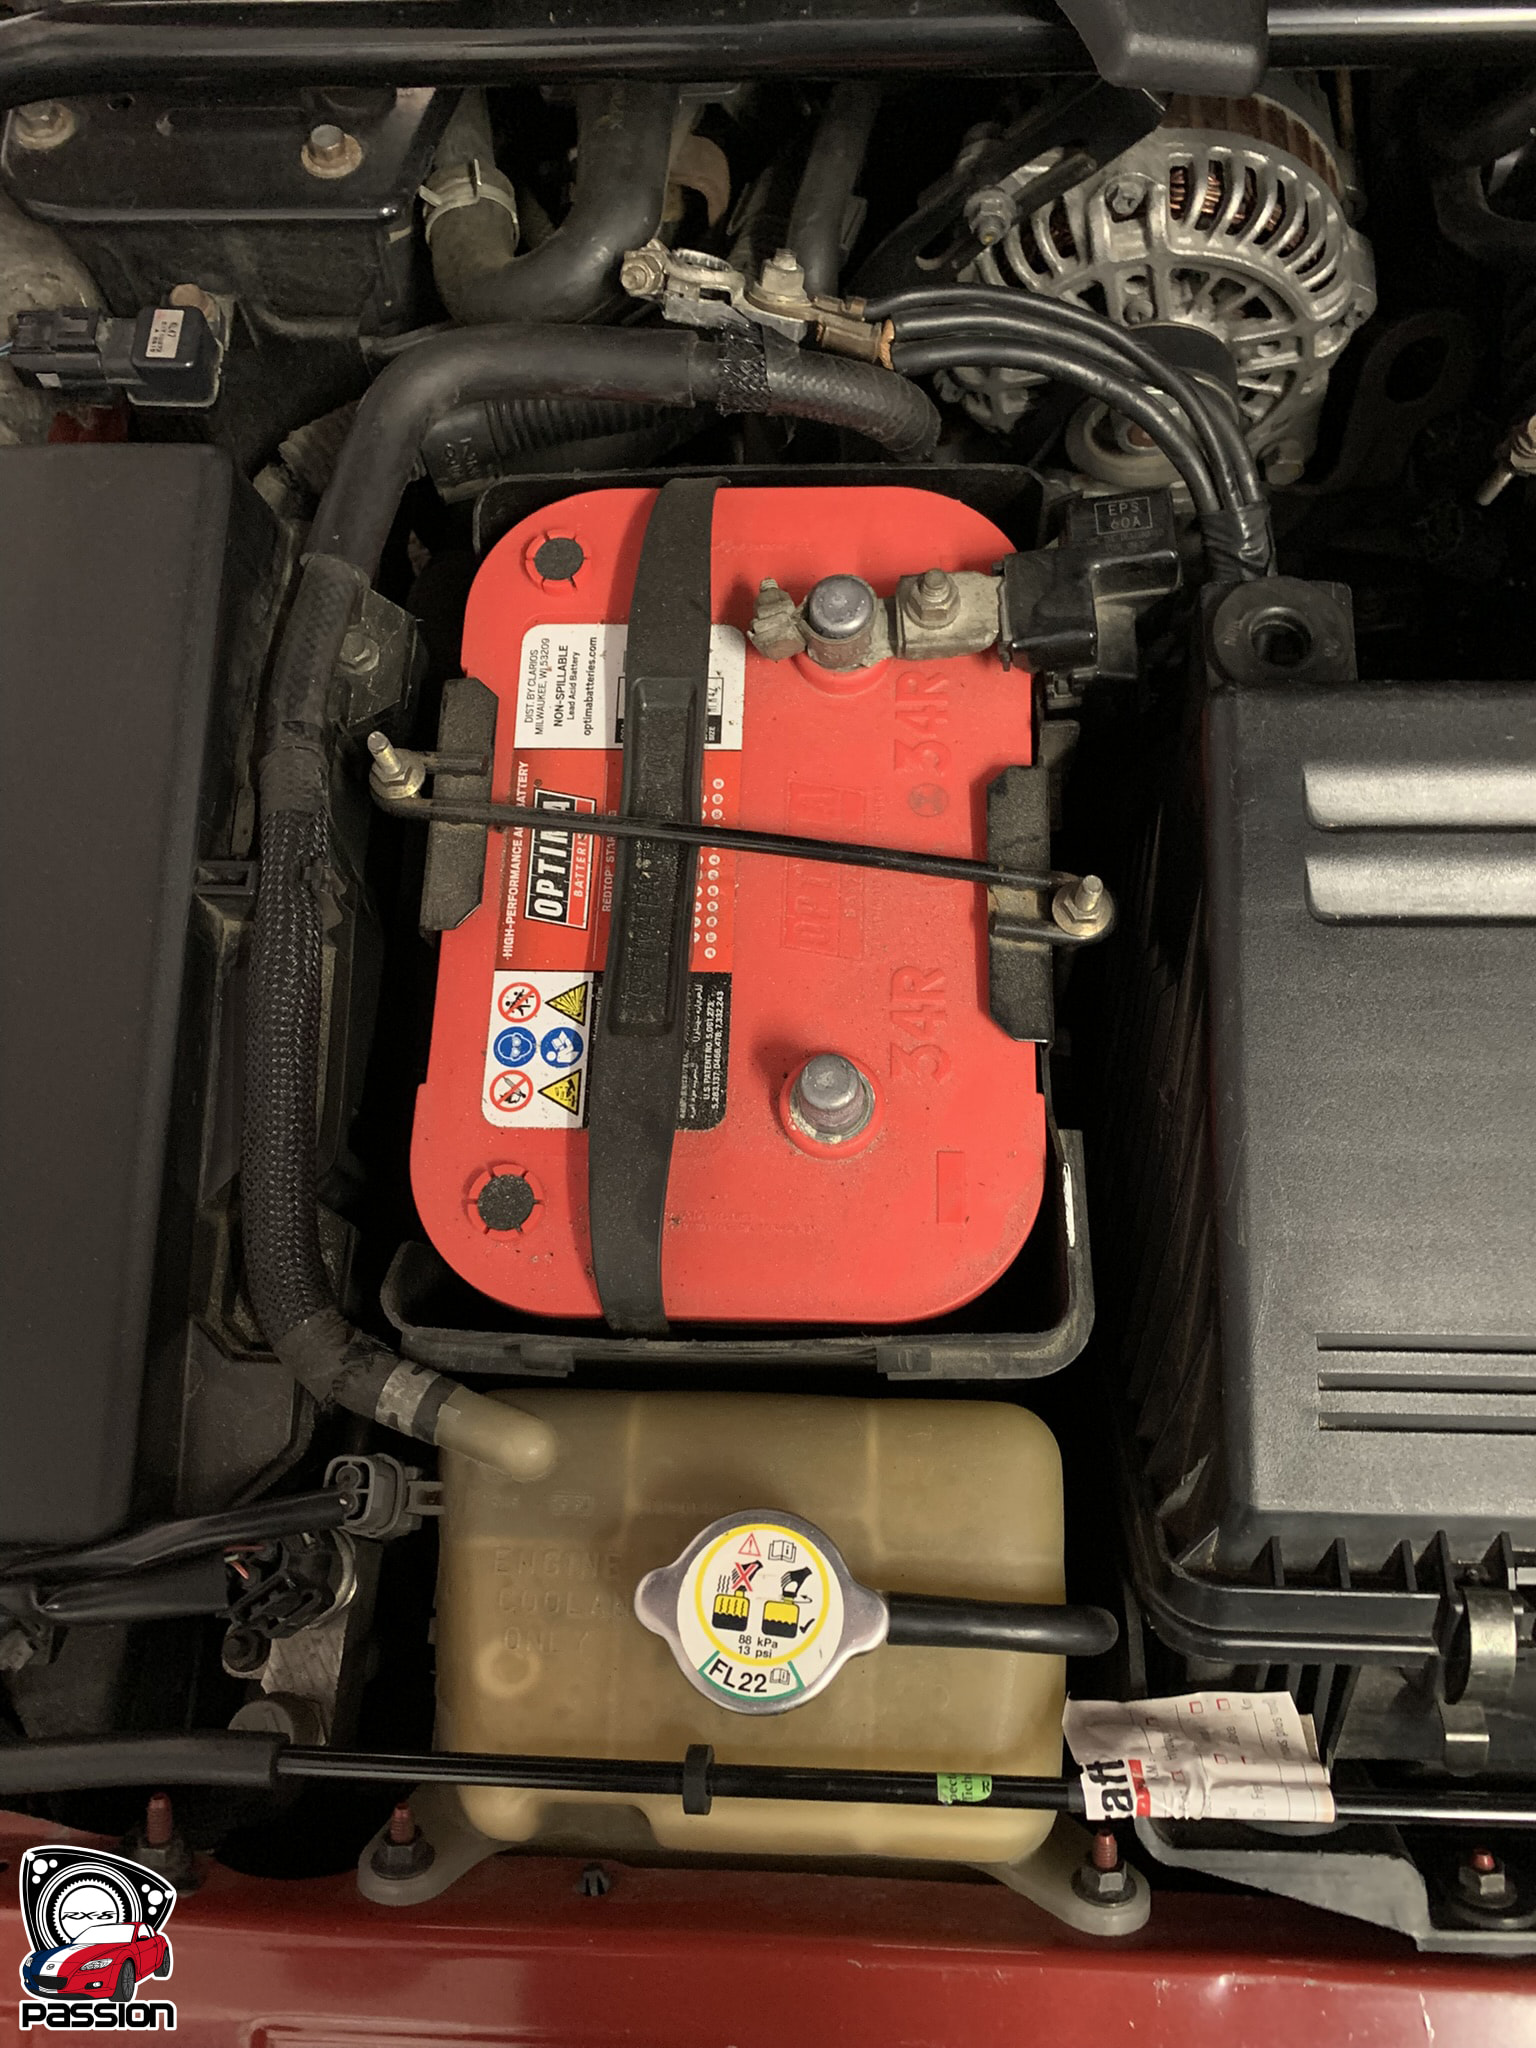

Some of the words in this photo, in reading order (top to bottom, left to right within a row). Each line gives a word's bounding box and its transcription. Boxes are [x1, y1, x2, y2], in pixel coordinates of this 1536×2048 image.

[1108, 502, 1139, 516] EPS
[1111, 516, 1141, 530] 60A
[540, 637, 550, 666] 53209
[527, 649, 539, 687] CLARIOS
[571, 652, 580, 681] Battery
[526, 688, 535, 700] BY
[553, 645, 568, 727] NON-SPILLABLE
[569, 682, 577, 700] Acid
[582, 636, 597, 736] optimabatteries.com
[567, 701, 576, 720] Lead
[893, 671, 952, 777] 34R
[889, 965, 951, 1083] 34R
[704, 1054, 713, 1084] PATENT
[738, 1634, 752, 1645] 88
[757, 1638, 778, 1649] kPa
[738, 1645, 750, 1656] 13
[755, 1649, 773, 1660] psi
[709, 1658, 768, 1693] FL22
